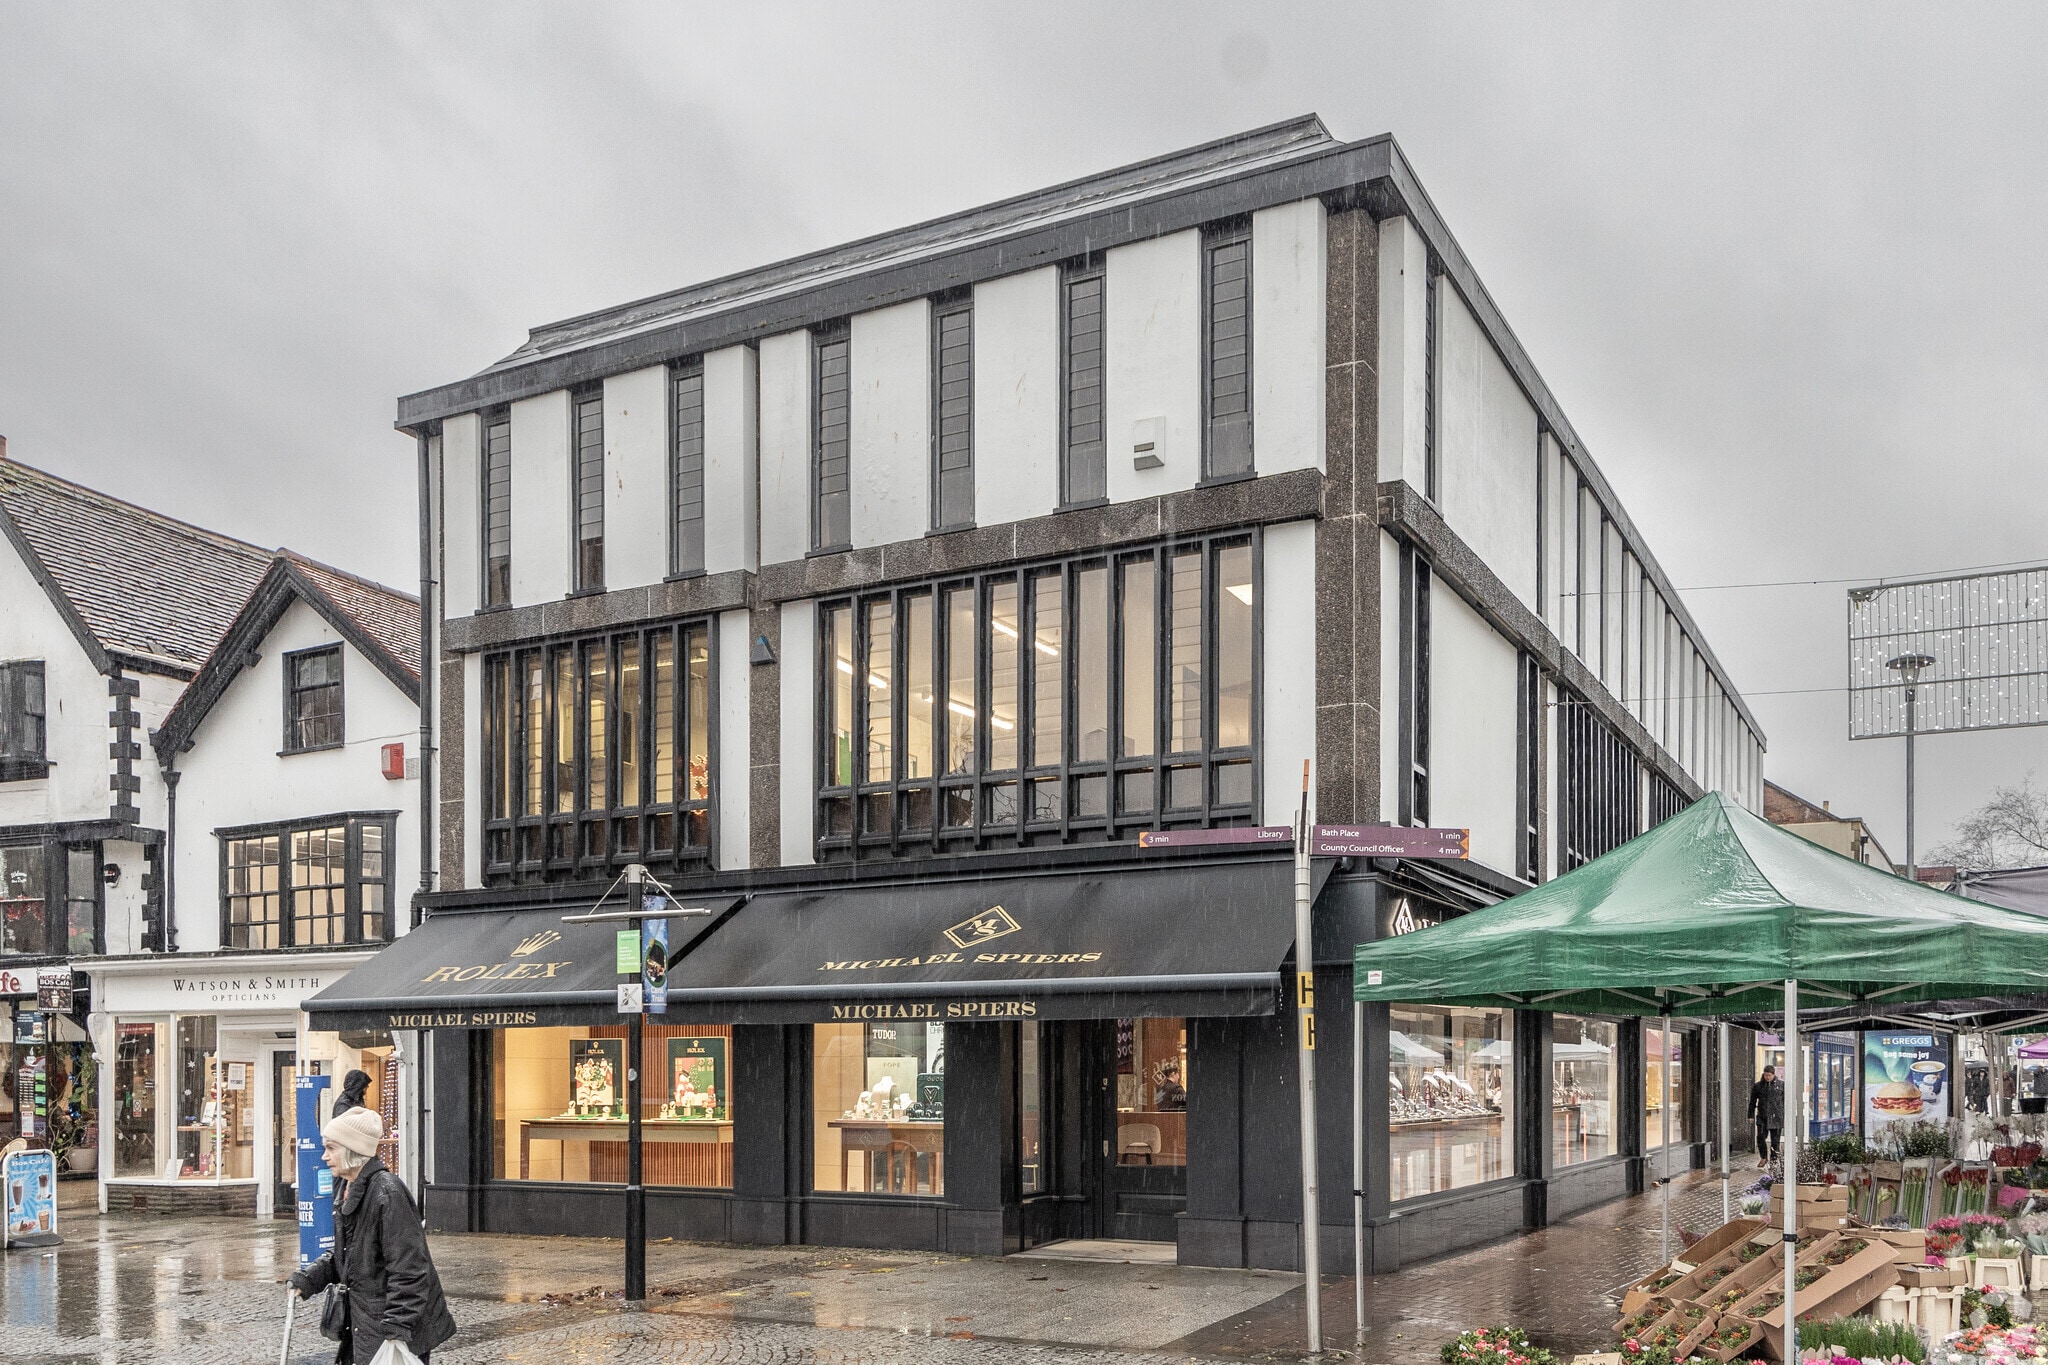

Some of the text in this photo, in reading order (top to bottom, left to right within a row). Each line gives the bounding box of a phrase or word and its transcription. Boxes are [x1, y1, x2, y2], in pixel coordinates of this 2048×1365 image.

[1155, 835, 1169, 843] min
[1257, 830, 1284, 840] Library
[1321, 829, 1338, 837] Bath
[1341, 829, 1360, 837] Place
[1445, 832, 1461, 840] min
[1320, 843, 1348, 853] County
[1349, 844, 1377, 852] Council
[1378, 845, 1405, 853] Offices
[816, 951, 1103, 971] MICHAEL SPIERS
[420, 961, 573, 982] ROLEX
[173, 976, 319, 992] WATSON & SMITH
[211, 993, 277, 1002] OPTICIANS
[831, 1000, 1037, 1020] MICHAEL SPIERS
[389, 1011, 537, 1028] MICHAEL SPIERS
[872, 1028, 897, 1040] TUDOR
[1891, 1037, 1929, 1045] GREGGS
[1883, 1051, 1930, 1060] Bag some joy
